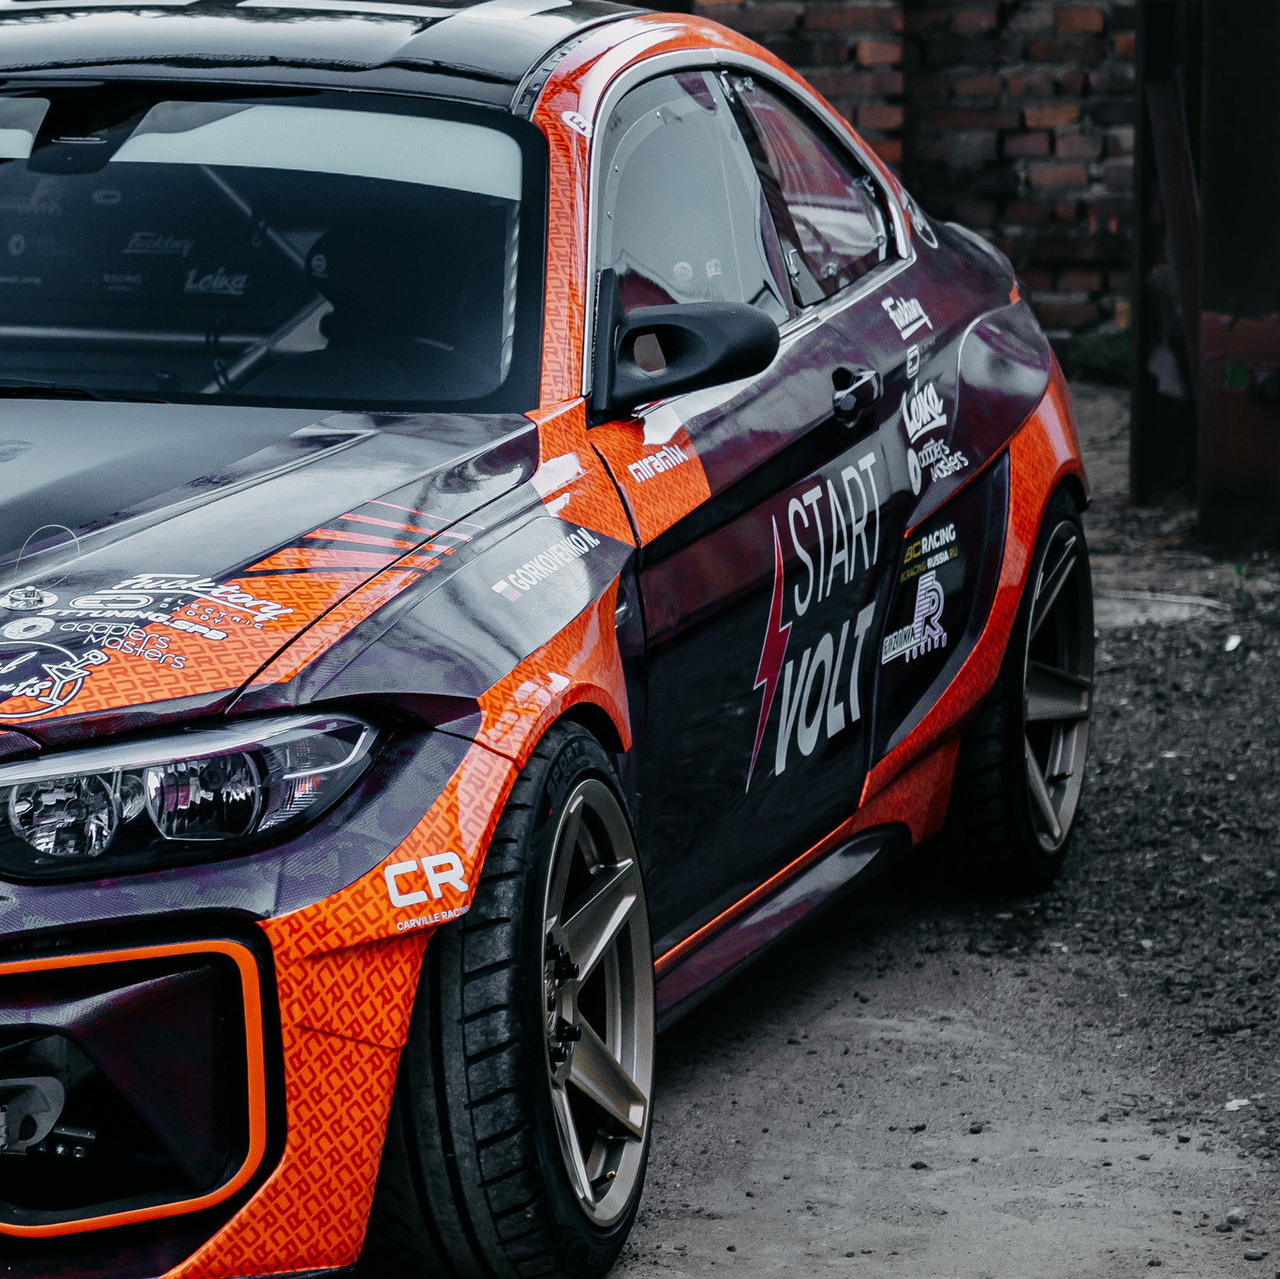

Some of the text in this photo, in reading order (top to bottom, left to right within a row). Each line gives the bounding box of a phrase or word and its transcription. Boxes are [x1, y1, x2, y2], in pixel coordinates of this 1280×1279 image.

[626, 444, 689, 484] miramix
[788, 451, 881, 617] START
[507, 532, 590, 592] GORKOVENKO
[112, 573, 295, 622] Fucktory
[159, 603, 223, 625] DADDY
[163, 597, 265, 630] ELECTRIC
[36, 609, 229, 641] STTUNING.SPB
[59, 621, 171, 650] adapters
[82, 633, 187, 670] Masters
[775, 600, 877, 777] VOLT
[383, 851, 470, 909] CR
[396, 904, 470, 932] CARVILLE RACING
